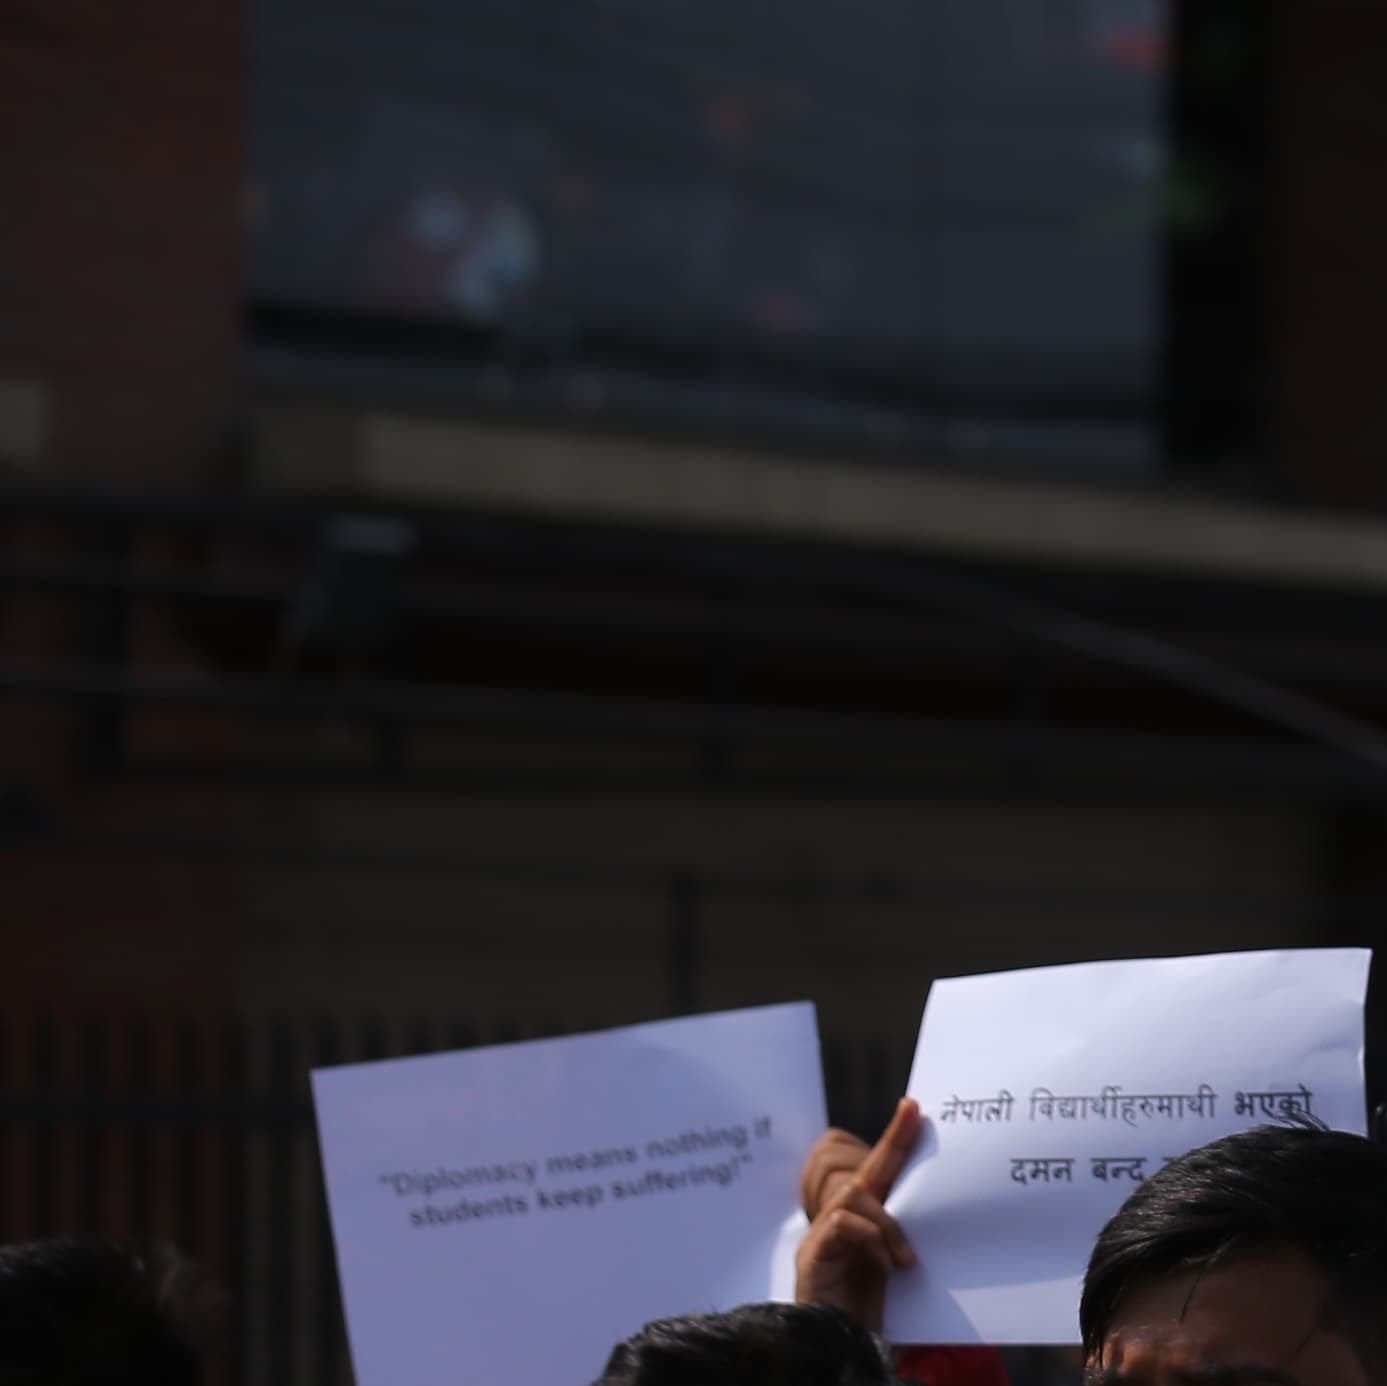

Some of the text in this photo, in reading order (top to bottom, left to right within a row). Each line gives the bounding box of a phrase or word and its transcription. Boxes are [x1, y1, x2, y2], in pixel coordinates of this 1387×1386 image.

[939, 1089, 1015, 1122] नेपाली
[546, 1146, 639, 1174] means
[645, 1124, 749, 1159] nothing
[753, 1116, 771, 1140] if
[1010, 1157, 1147, 1185] दमन बन्द
[409, 1193, 529, 1228] students
[536, 1182, 605, 1210] keep
